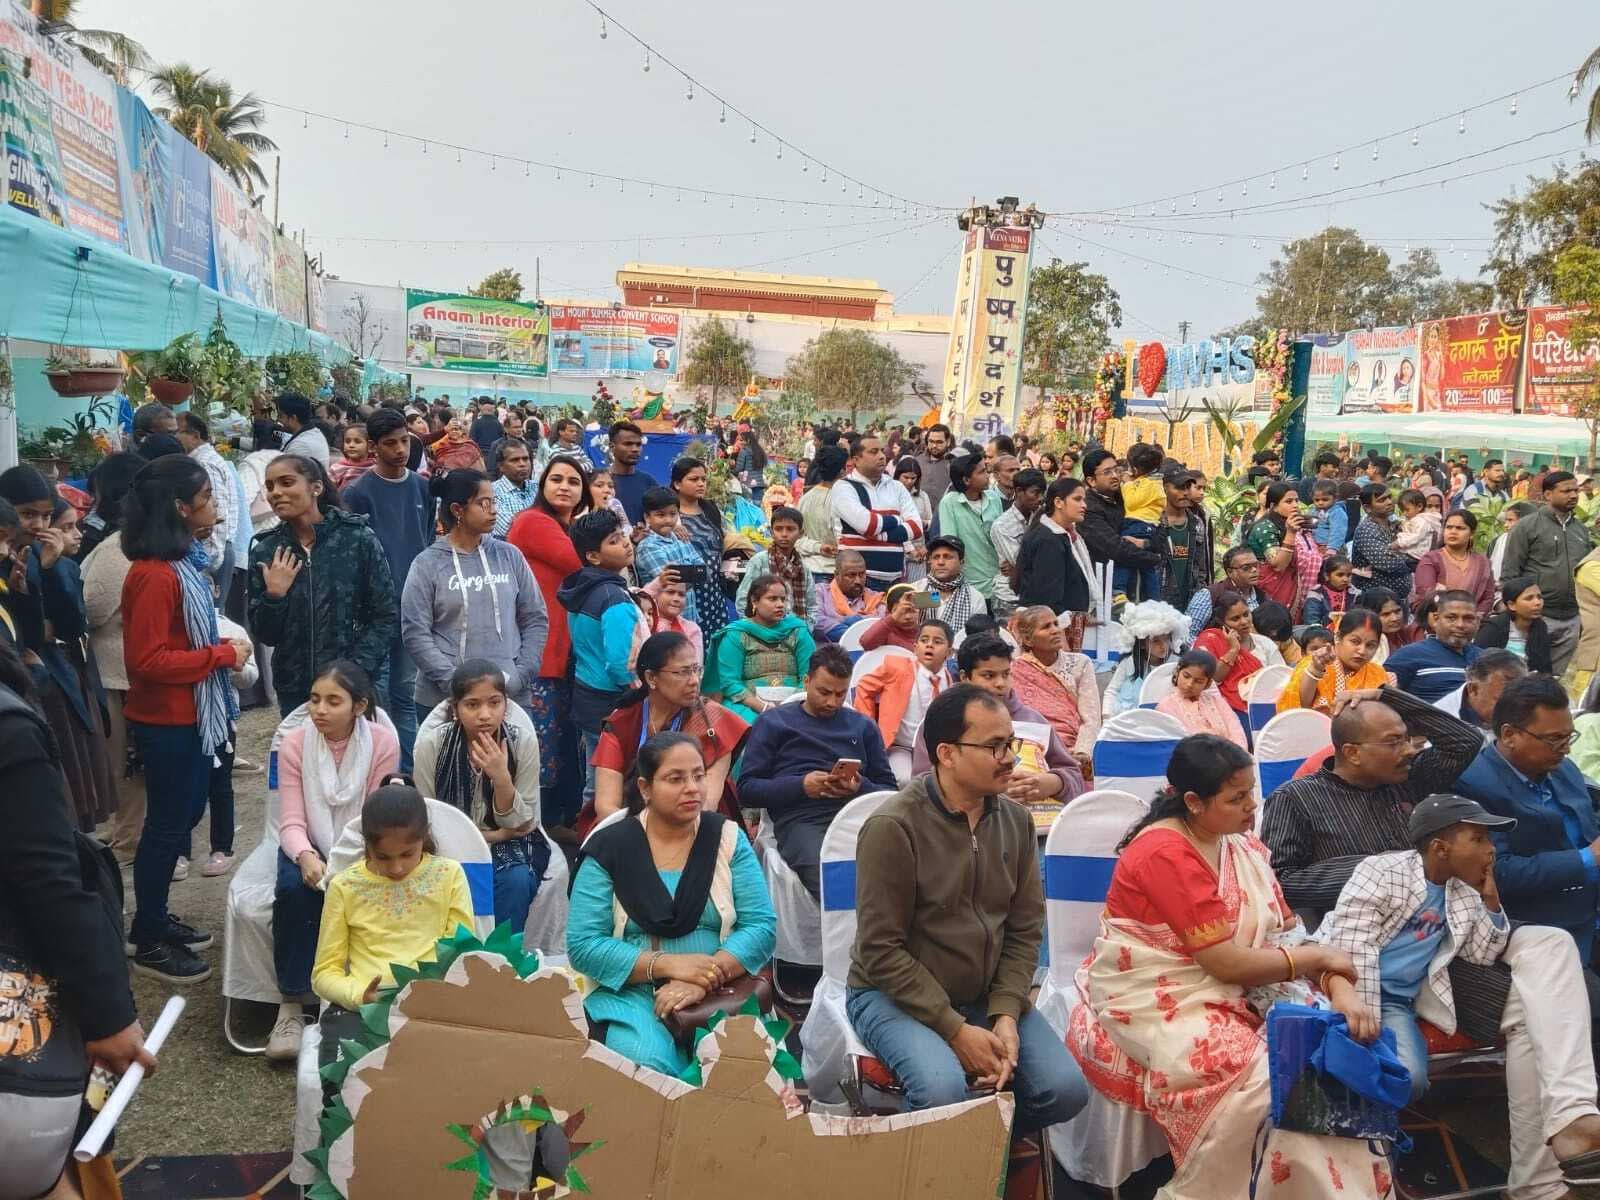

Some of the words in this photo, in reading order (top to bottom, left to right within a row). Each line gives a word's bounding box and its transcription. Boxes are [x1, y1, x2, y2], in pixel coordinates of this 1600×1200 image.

[423, 305, 474, 324] Anam
[479, 311, 541, 330] Interior
[567, 308, 589, 318] MOUNT
[591, 309, 616, 320] SUMMER
[617, 309, 648, 321] CONVENT
[650, 312, 677, 324] SCHOOL
[1446, 389, 1458, 405] 20
[1481, 388, 1500, 404] 100
